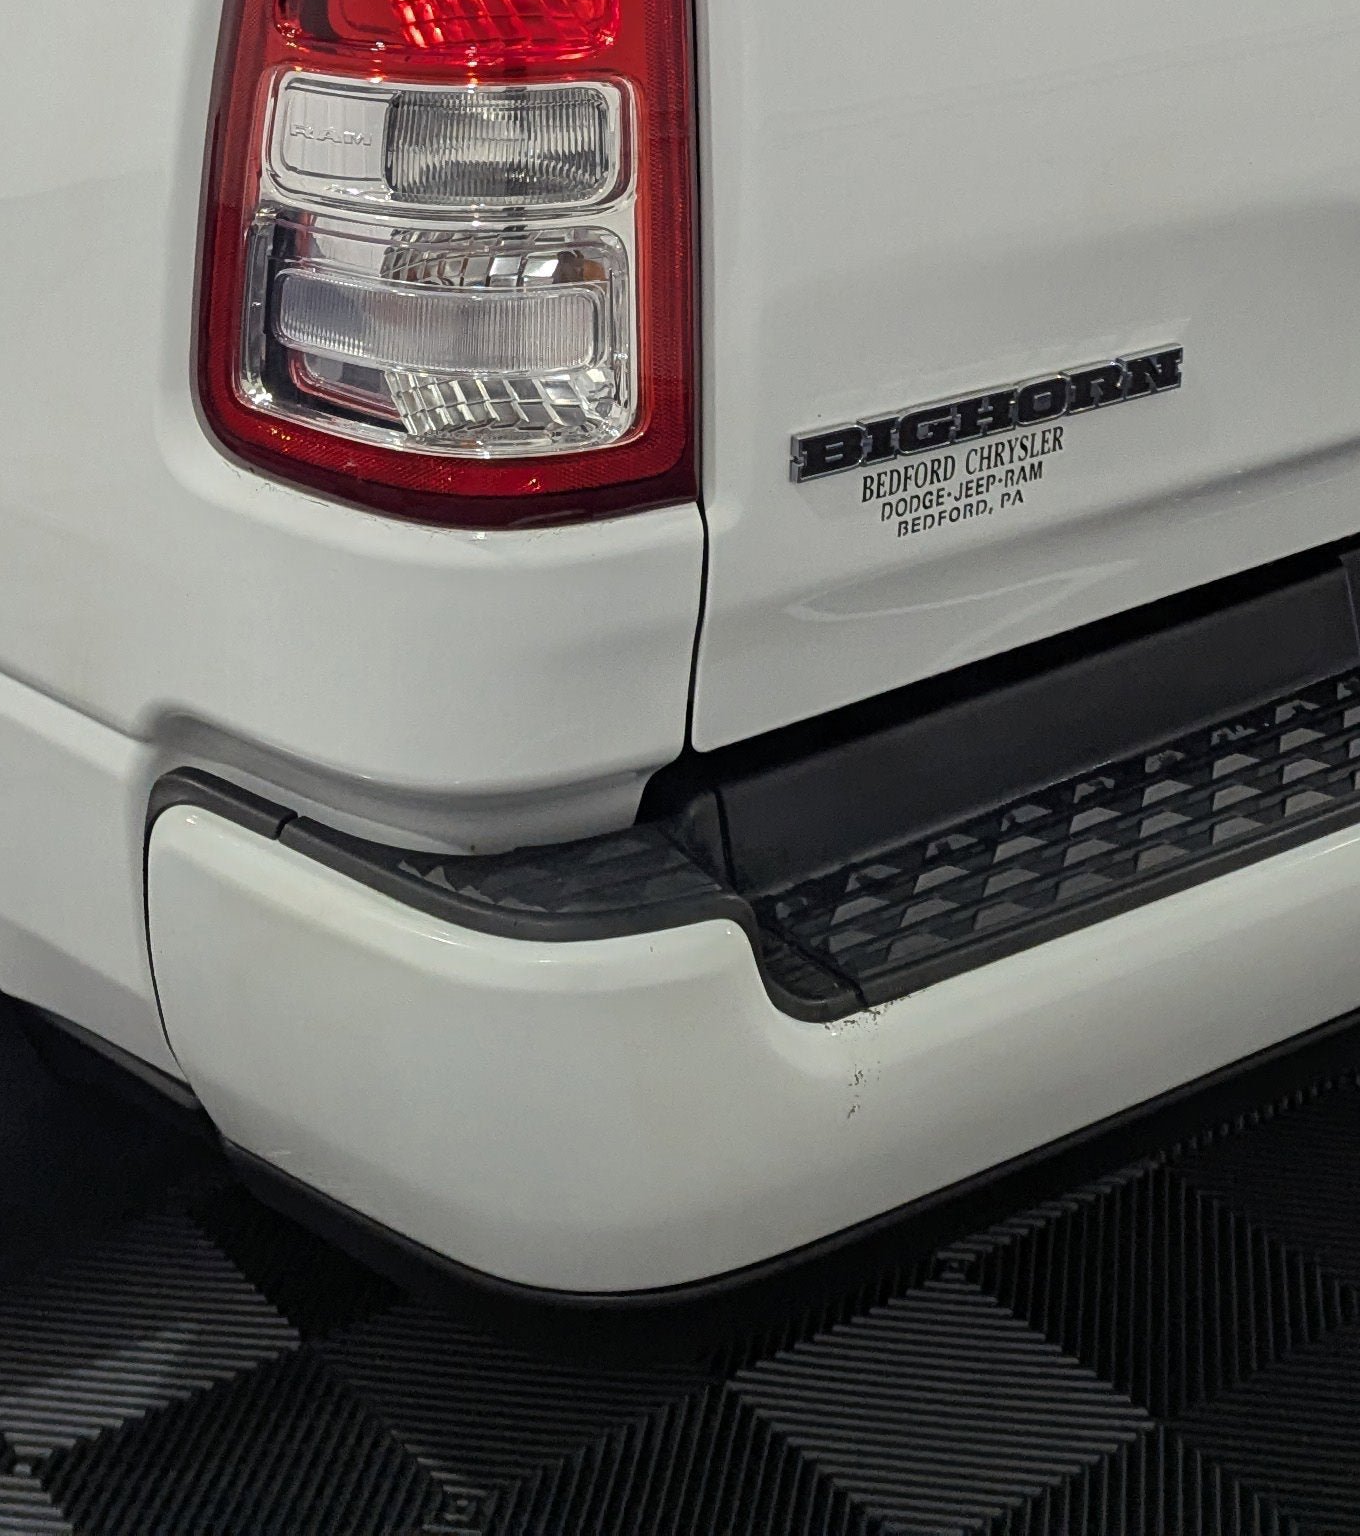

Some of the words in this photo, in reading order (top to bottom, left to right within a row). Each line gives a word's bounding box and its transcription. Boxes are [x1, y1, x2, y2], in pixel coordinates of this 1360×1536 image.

[290, 124, 372, 146] RAM
[790, 343, 1184, 483] BIGHORN
[861, 455, 956, 503] BEDFORD
[965, 425, 1064, 475] CHRYSLER
[896, 499, 994, 538] BEDFORD,
[1000, 489, 1025, 508] PA
